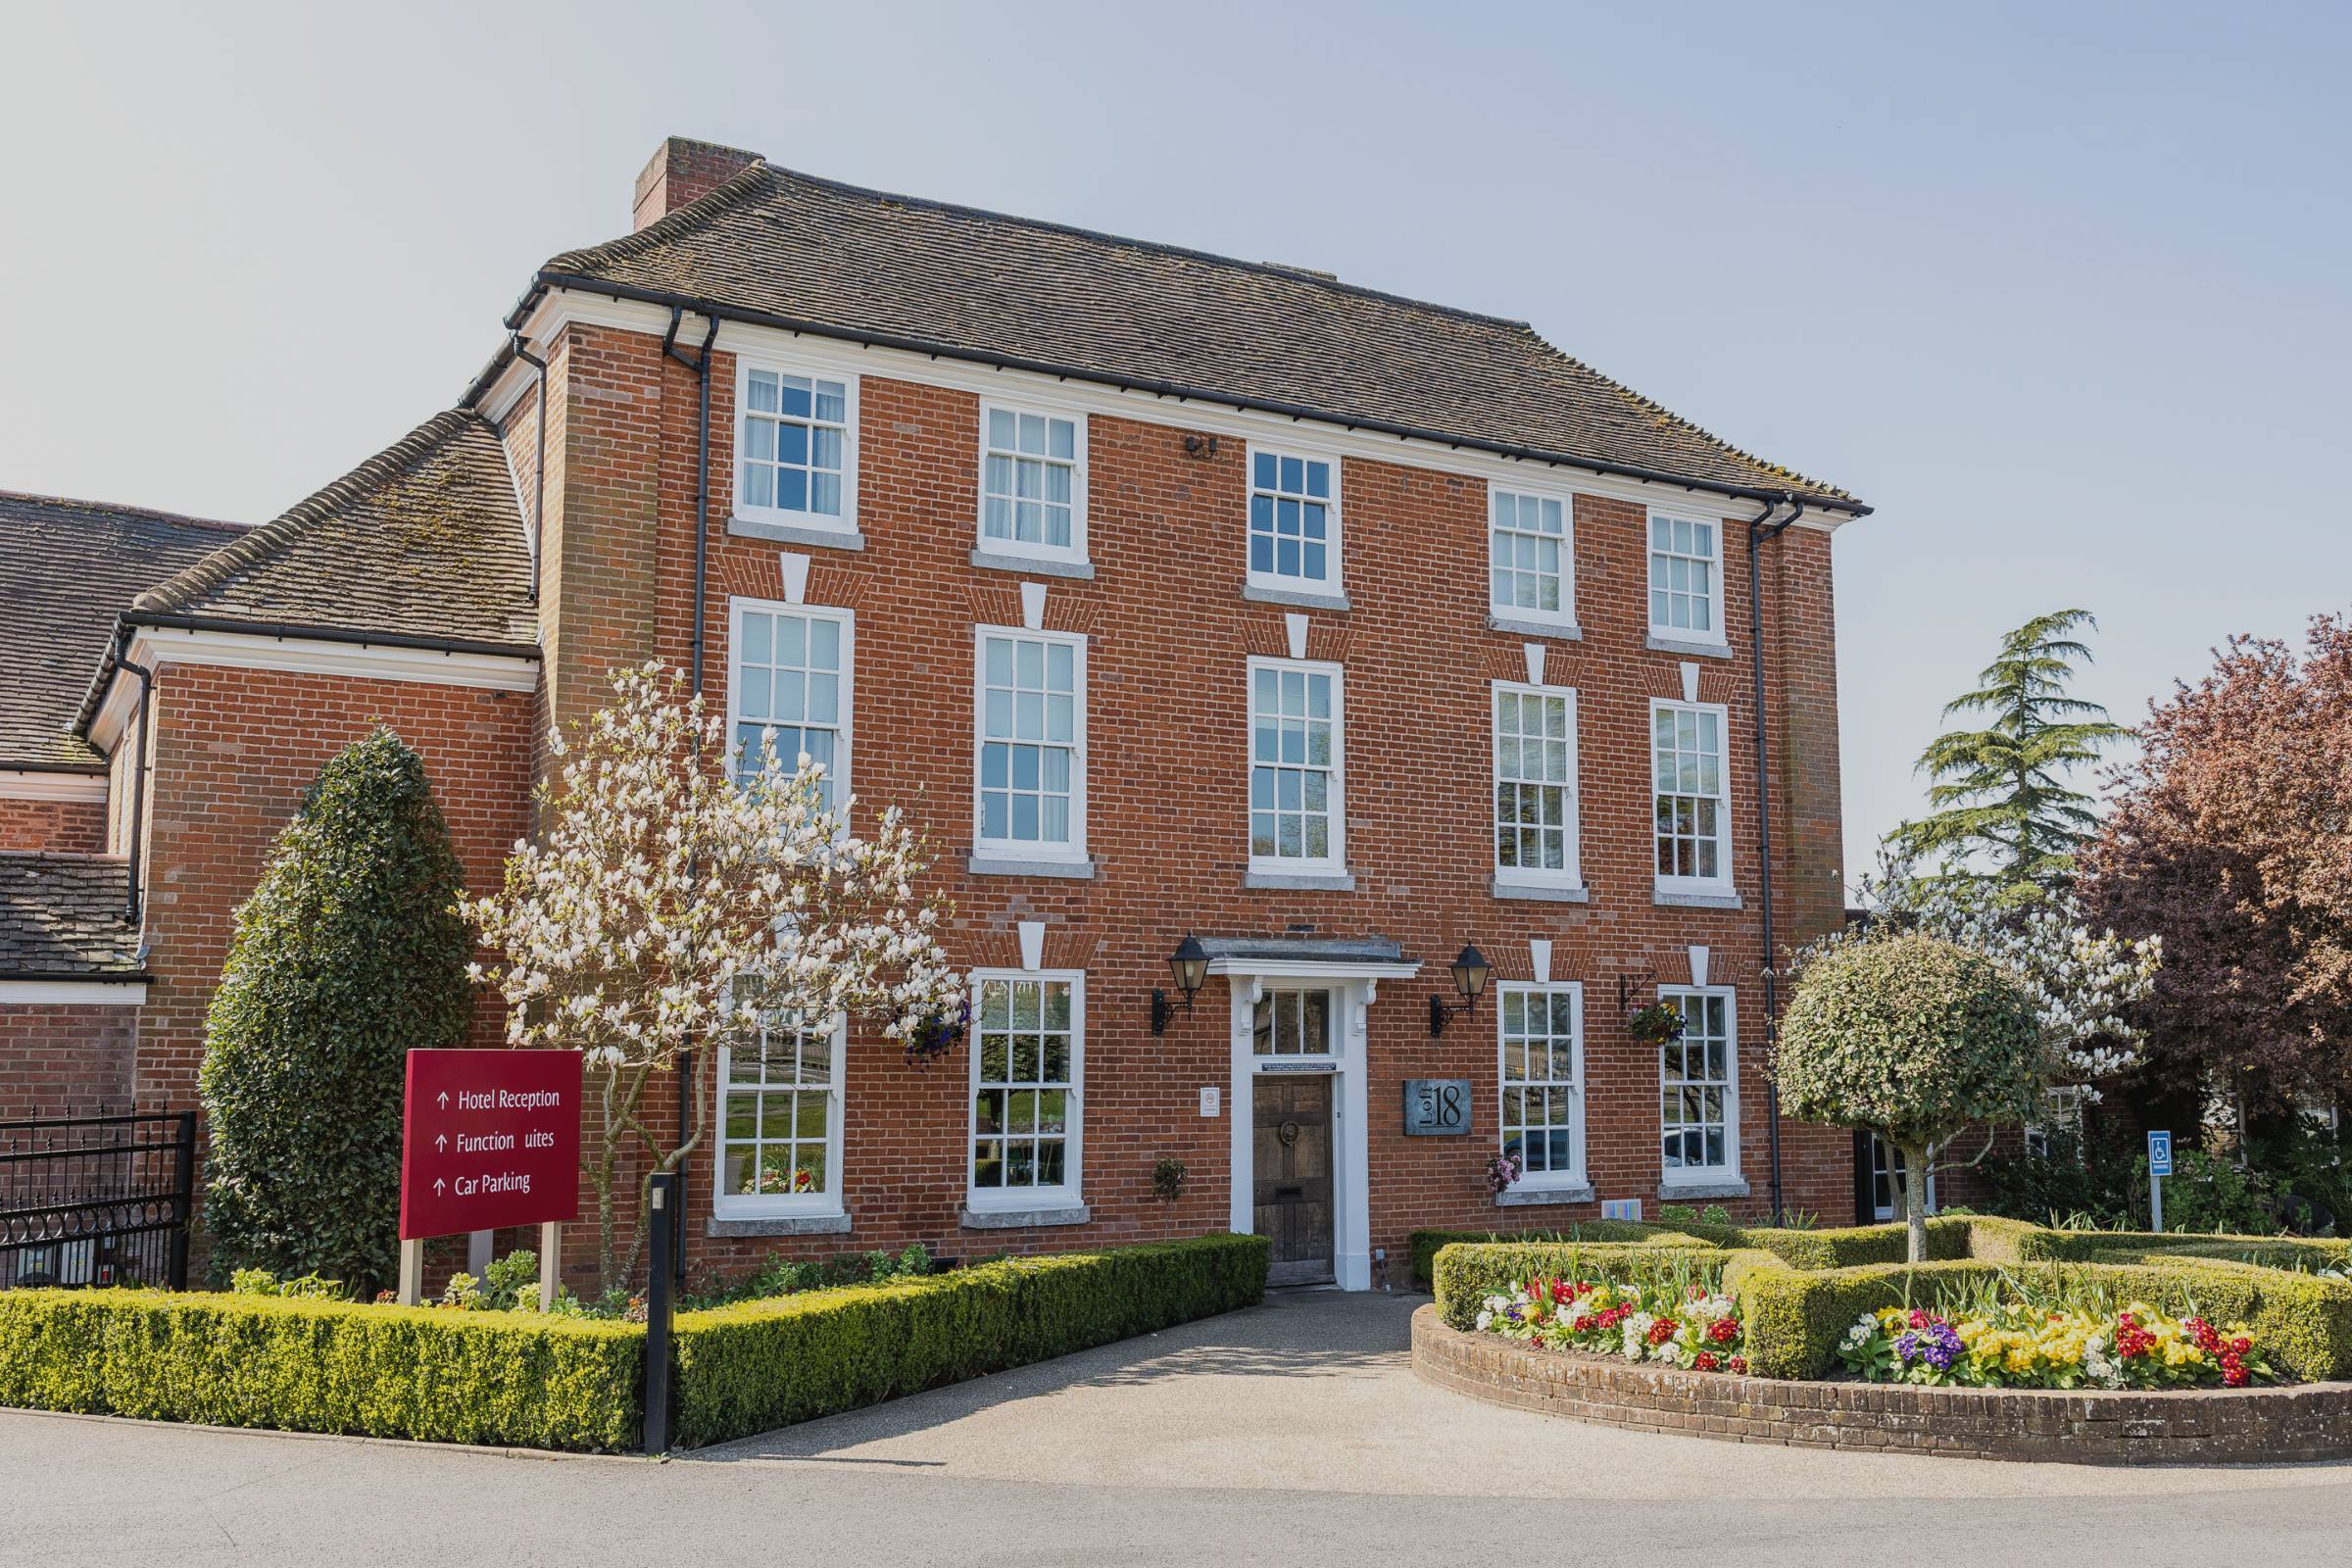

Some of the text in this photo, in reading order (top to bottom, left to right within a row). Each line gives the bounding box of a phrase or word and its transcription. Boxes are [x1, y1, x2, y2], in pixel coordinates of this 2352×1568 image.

[459, 1089, 560, 1112] Hotel Reception
[1433, 1085, 1461, 1126] 18
[457, 1129, 555, 1153] Function uites
[455, 1171, 531, 1196] Car Parking
